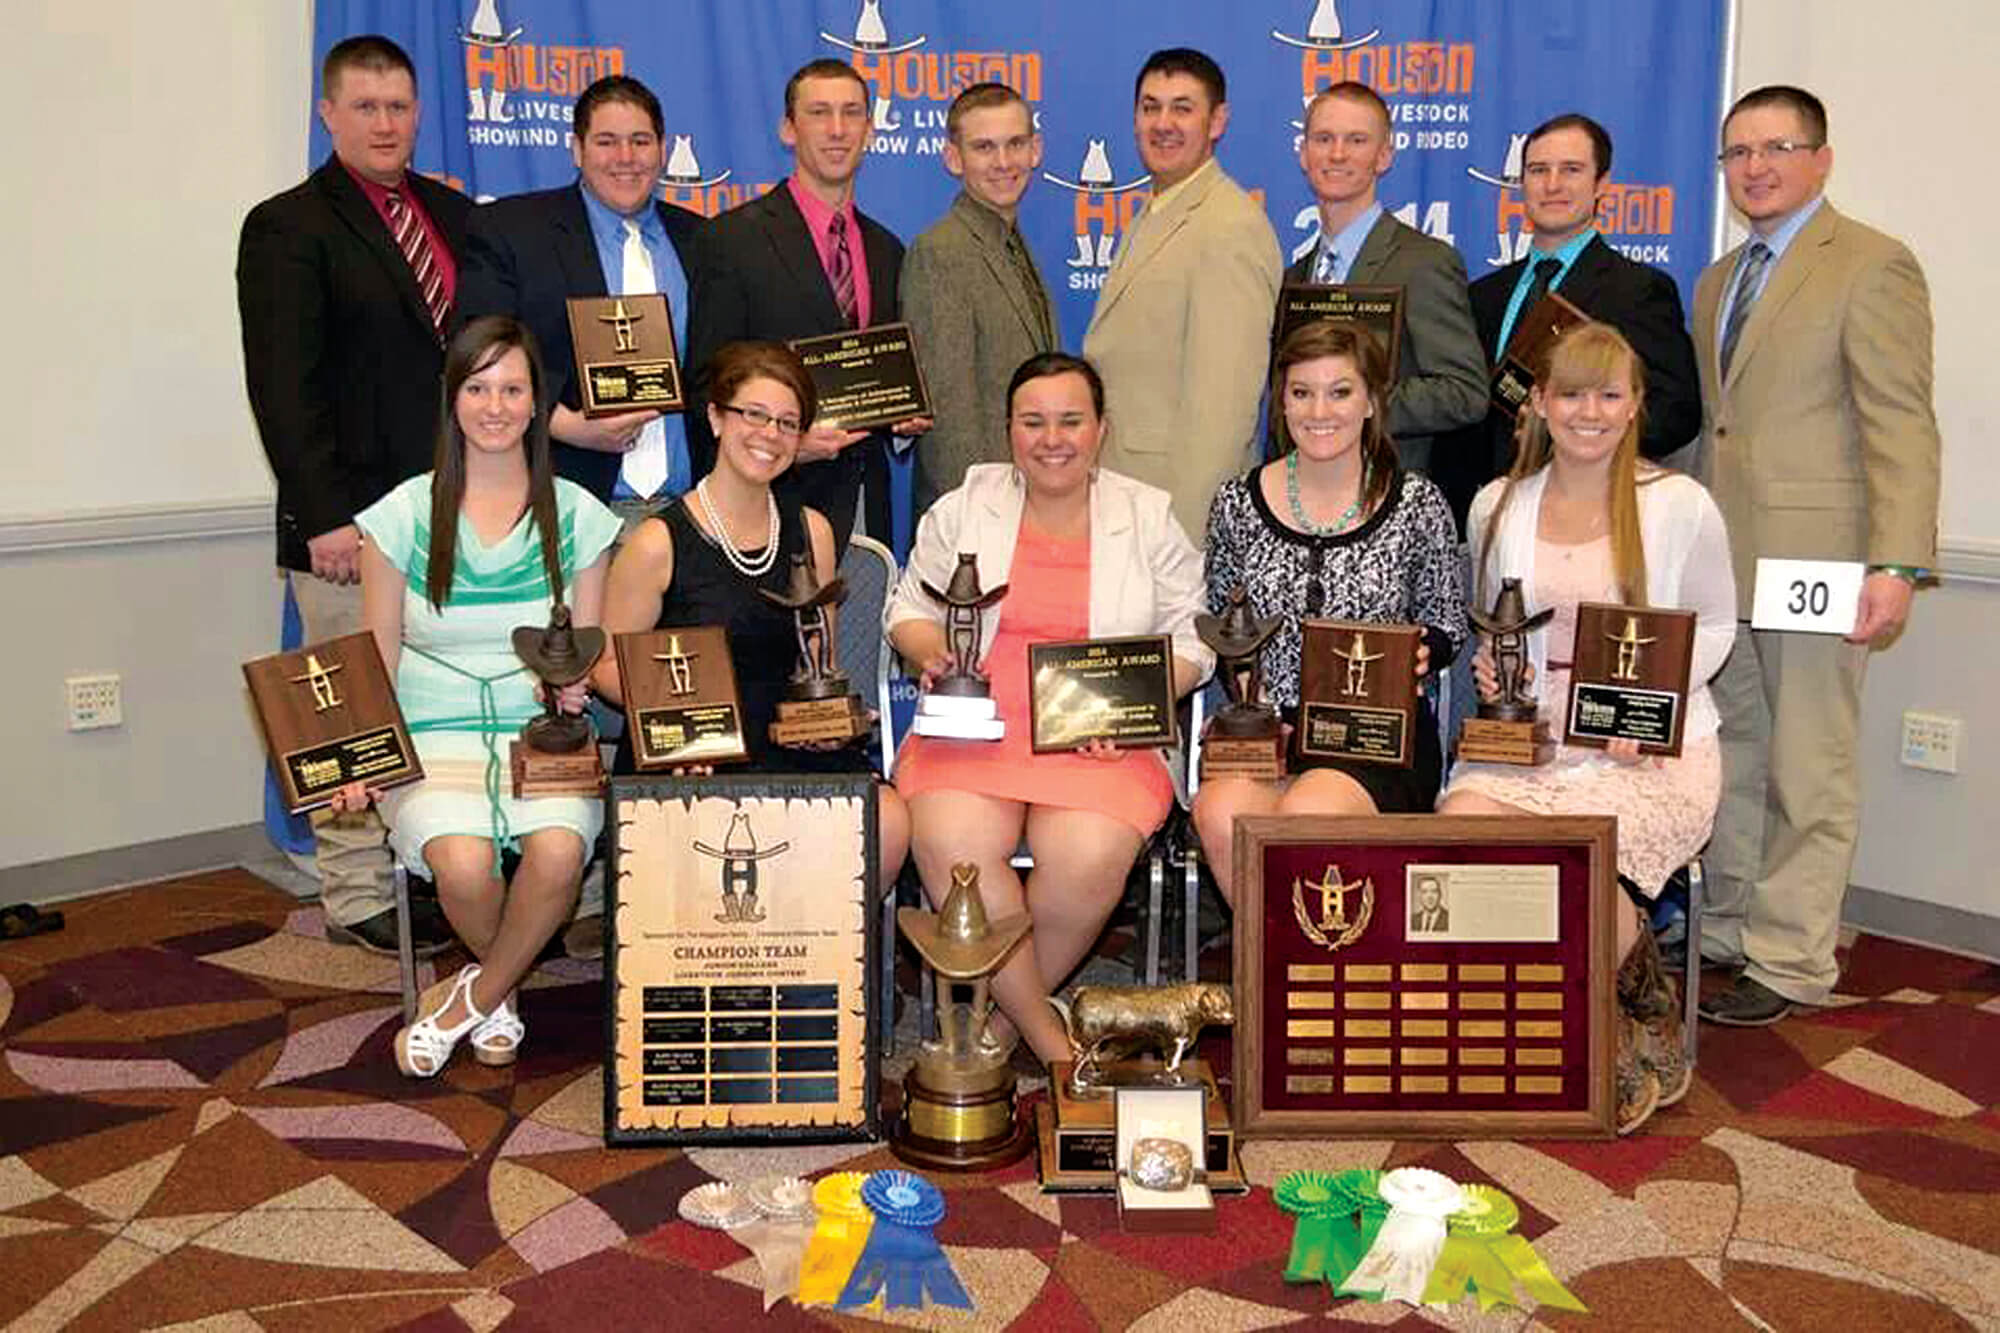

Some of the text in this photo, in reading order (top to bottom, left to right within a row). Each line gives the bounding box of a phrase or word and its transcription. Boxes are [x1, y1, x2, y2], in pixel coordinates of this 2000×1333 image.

[519, 101, 574, 122] LIVES
[915, 136, 946, 155] AN
[1788, 580, 1829, 616] 30
[673, 945, 808, 960] CHAMPION TEAM
